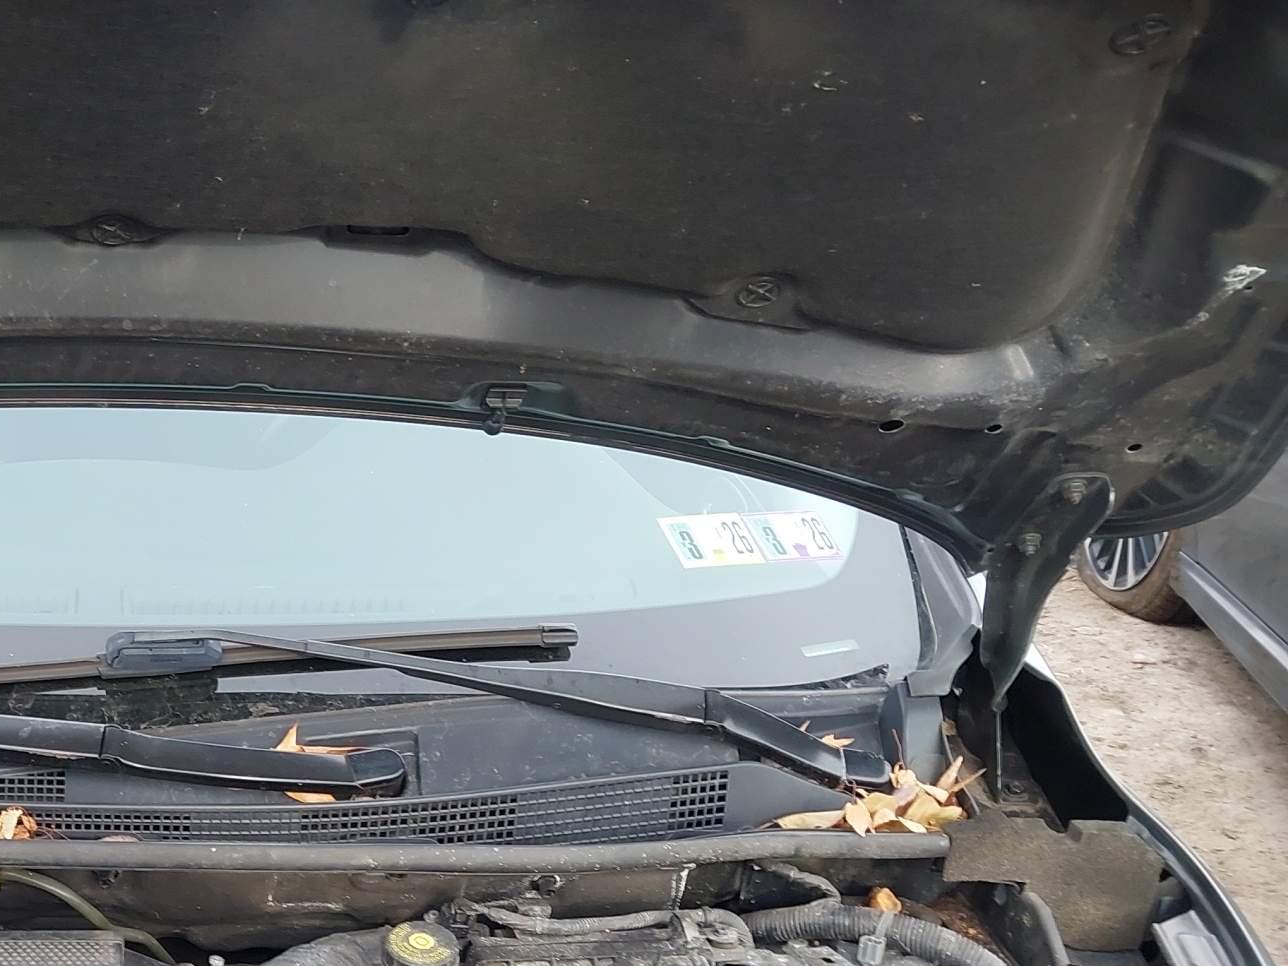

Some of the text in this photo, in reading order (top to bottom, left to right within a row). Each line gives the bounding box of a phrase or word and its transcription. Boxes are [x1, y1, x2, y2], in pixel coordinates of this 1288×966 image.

[678, 521, 754, 560] 3 26
[763, 517, 834, 555] 3 26
